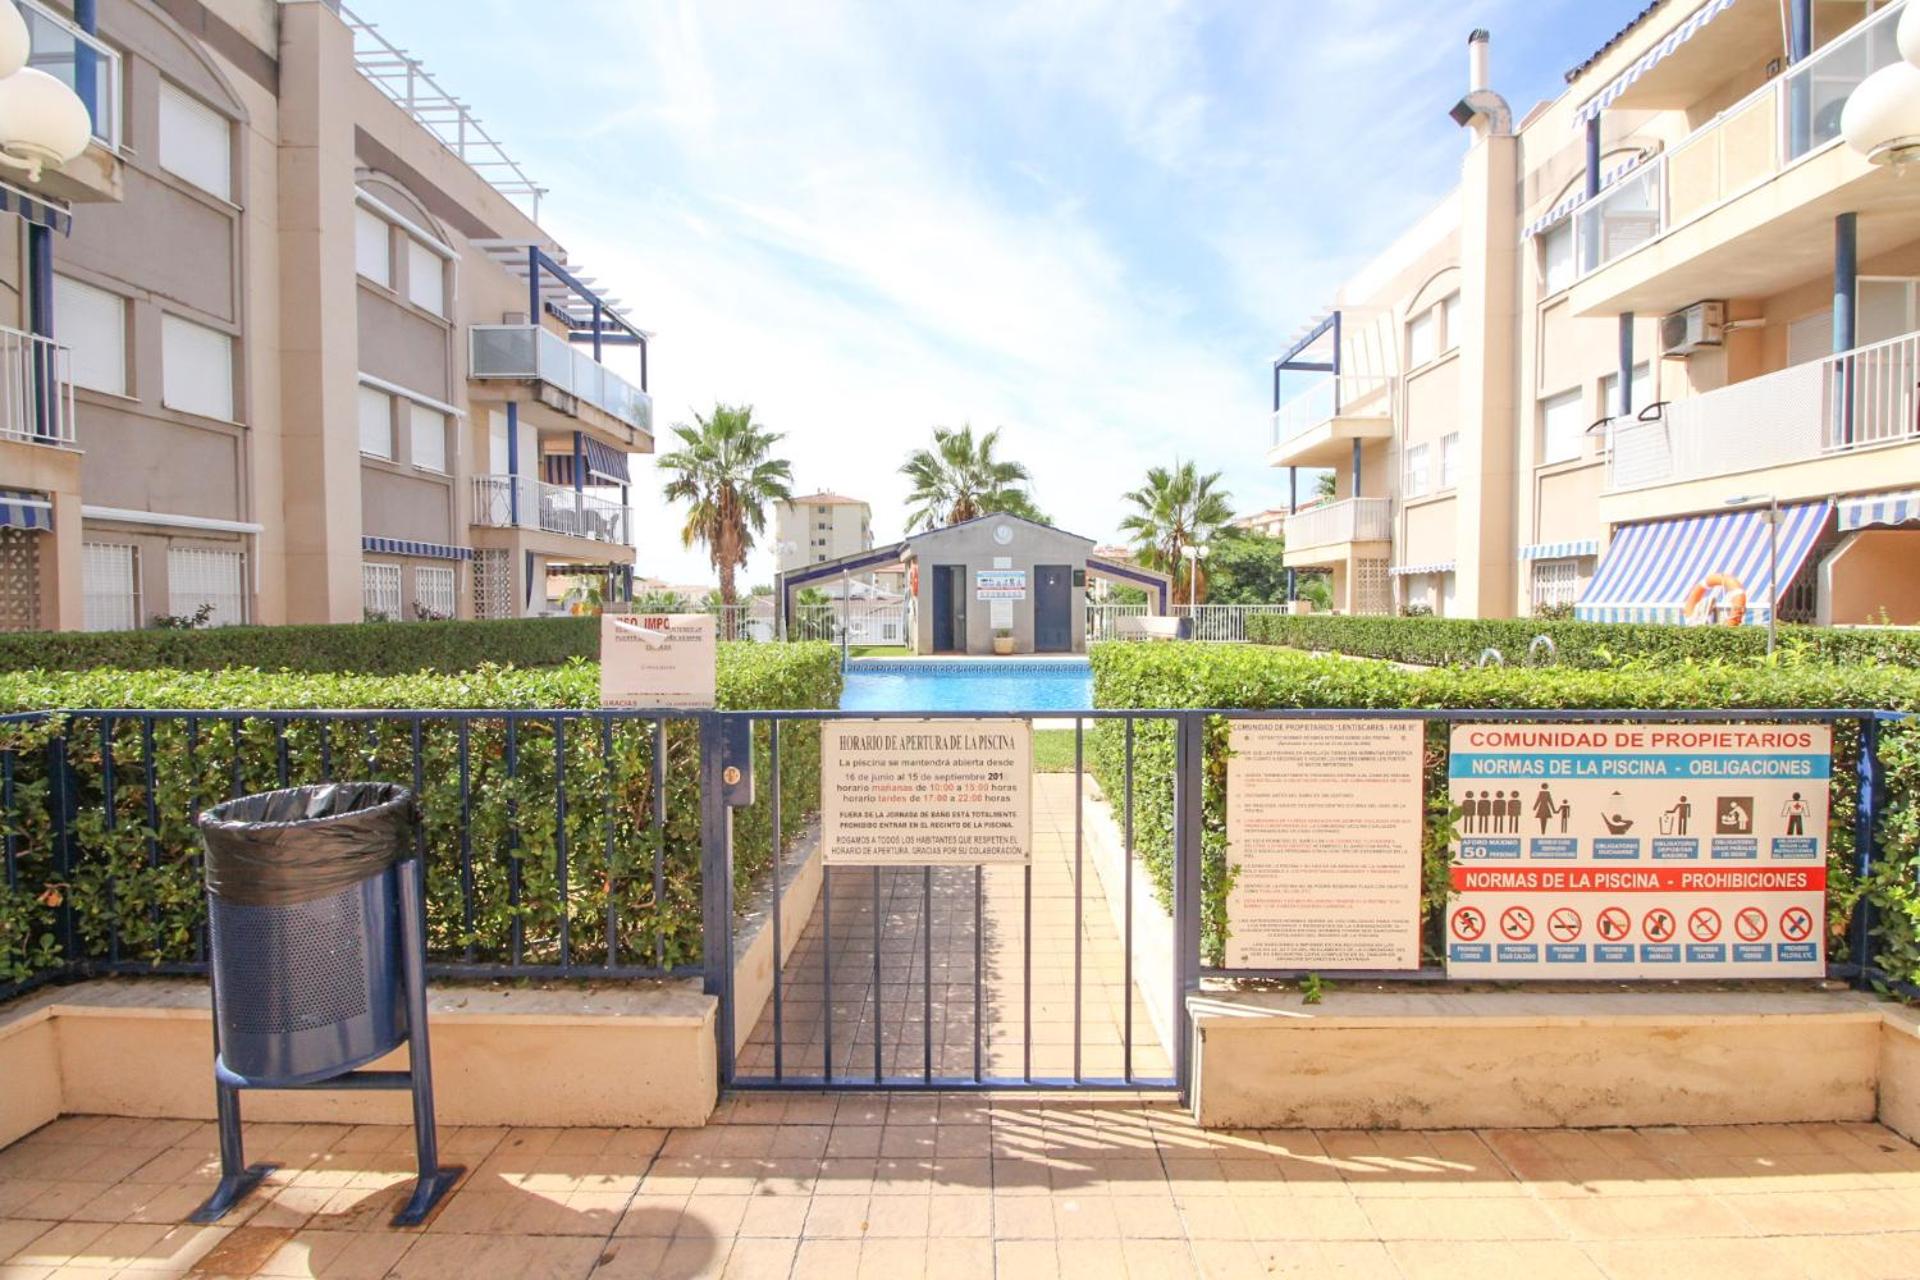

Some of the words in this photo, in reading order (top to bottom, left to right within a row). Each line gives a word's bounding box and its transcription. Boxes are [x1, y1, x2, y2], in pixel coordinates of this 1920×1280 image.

[840, 735, 883, 750] HORARIO
[886, 735, 897, 750] DE
[900, 735, 948, 750] APERTURA
[950, 735, 962, 750] DE
[964, 735, 977, 750] LA
[978, 735, 1015, 750] PISCINA
[1470, 732, 1608, 748] COMUNIDAD
[1616, 732, 1644, 748] DE
[1652, 732, 1812, 748] PROPIETARIOS
[839, 758, 850, 766] La
[853, 758, 886, 768] piscina
[901, 758, 950, 766] mantendrá
[952, 758, 984, 766] abierta
[986, 758, 1014, 766] desde
[1472, 760, 1545, 774] NORMAS
[1550, 760, 1572, 774] DE
[1576, 760, 1598, 774] LA
[1602, 760, 1667, 774] PISCINA
[1689, 760, 1812, 774] OBLIGACIONES
[870, 773, 894, 783] junio
[934, 773, 986, 784] septiembre
[988, 772, 1004, 780] 201
[836, 836, 870, 844] ROGAMOS
[872, 836, 876, 844] A
[878, 836, 900, 844] TODOS
[902, 836, 914, 844] LOS
[916, 836, 956, 844] HABITANTES
[958, 836, 972, 844] QUE
[1010, 836, 1018, 844] EL
[832, 847, 861, 855] HORARIO
[863, 847, 872, 855] DE
[912, 847, 941, 855] GRACIAS
[943, 847, 956, 855] POR
[958, 847, 967, 855] SU
[1464, 847, 1486, 858] 50
[1466, 872, 1537, 888] NORMAS
[1542, 872, 1565, 888] DE
[1570, 872, 1591, 888] LA
[1594, 872, 1660, 888] PISCINA
[1682, 872, 1807, 888] PROHIBICIONES
